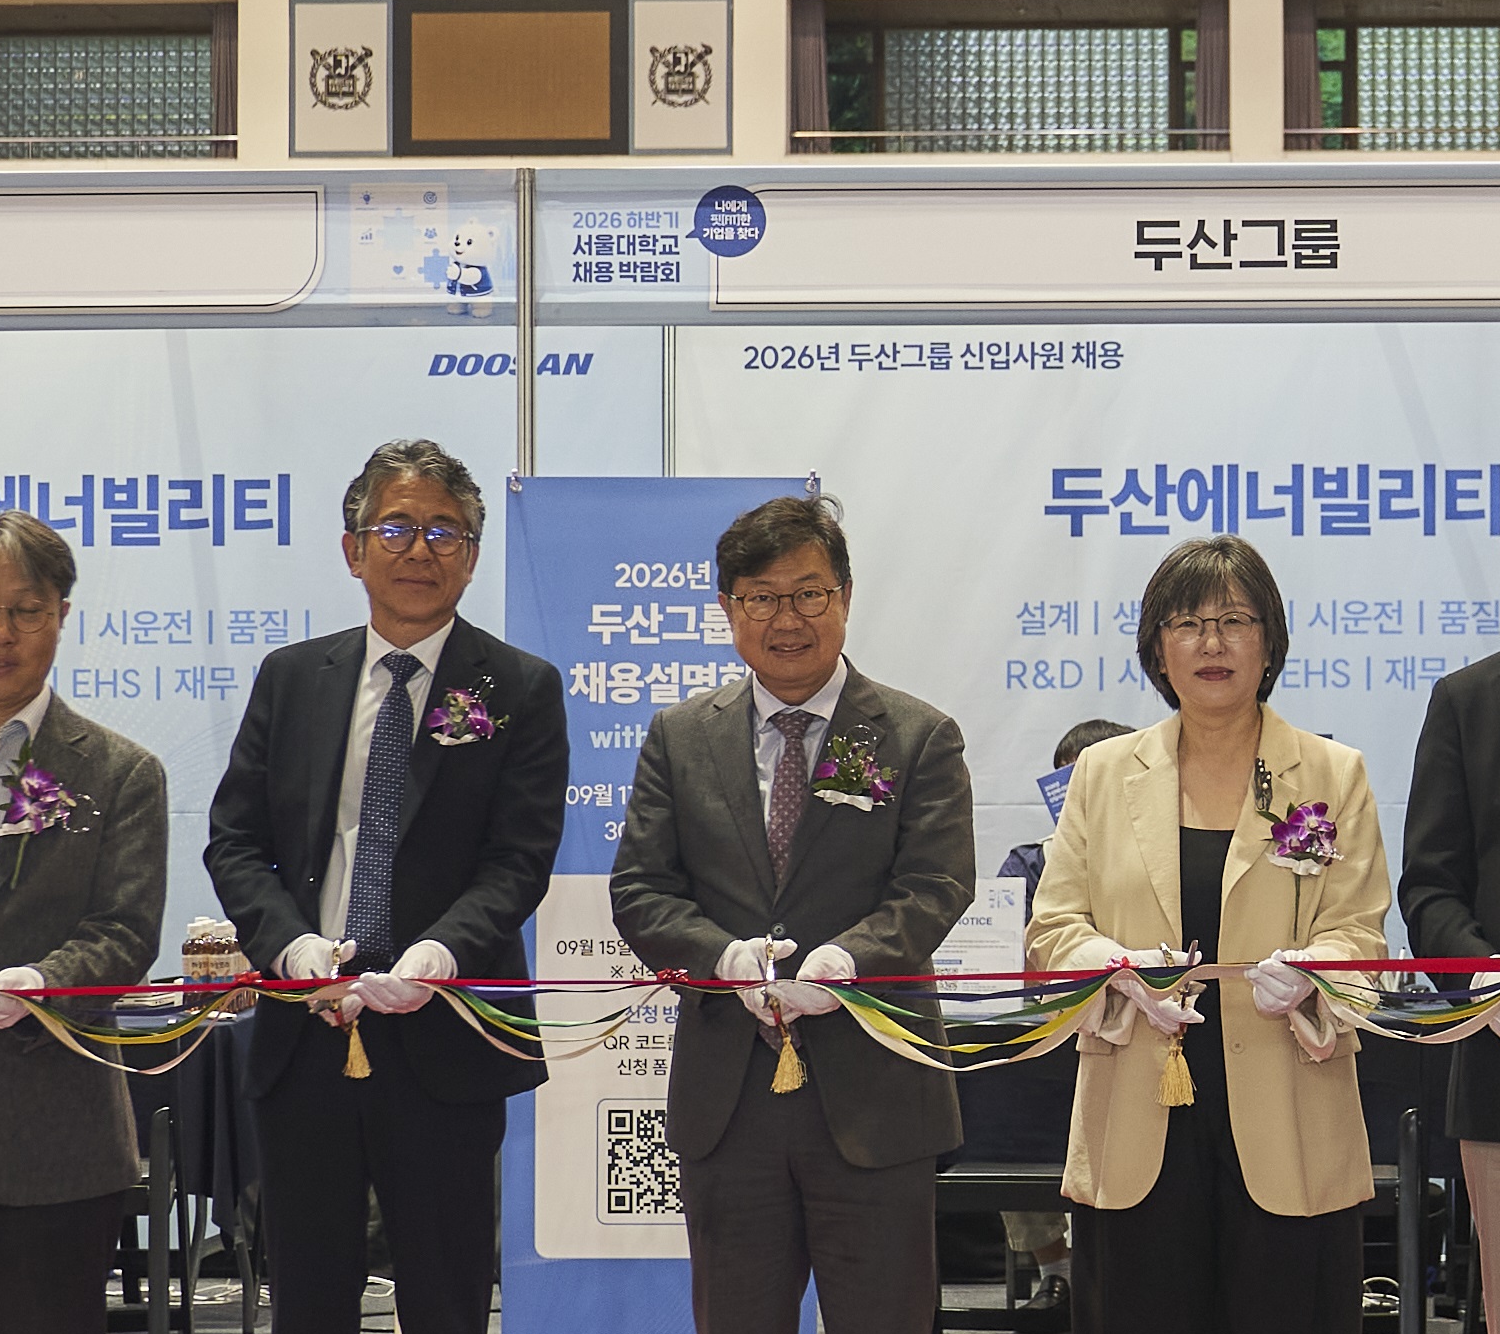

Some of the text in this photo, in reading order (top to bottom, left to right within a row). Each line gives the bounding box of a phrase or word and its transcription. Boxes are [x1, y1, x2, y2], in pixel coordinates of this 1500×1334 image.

[715, 200, 748, 212] 나에게
[573, 211, 678, 228] 2026 하반기
[573, 234, 680, 255] 서울대학교
[703, 227, 759, 240] 기업을 찾다
[1135, 220, 1340, 271] 두산그룹
[573, 262, 679, 282] 채용 박람회
[744, 341, 1123, 371] 2026년 두산그룹 신입사원 채용
[615, 561, 711, 590] 2026년
[99, 610, 192, 645] 시운전
[228, 609, 290, 645] 품질
[588, 603, 734, 645] 두산그룹
[1016, 600, 1500, 635] 설계 시운전 품질
[73, 669, 140, 698] EHS
[175, 666, 238, 701] 재무
[1007, 656, 1447, 691] R&D EHS 재무
[565, 784, 613, 806] 09월
[604, 1036, 629, 1049] QR
[618, 1059, 667, 1075] 신청 폼
